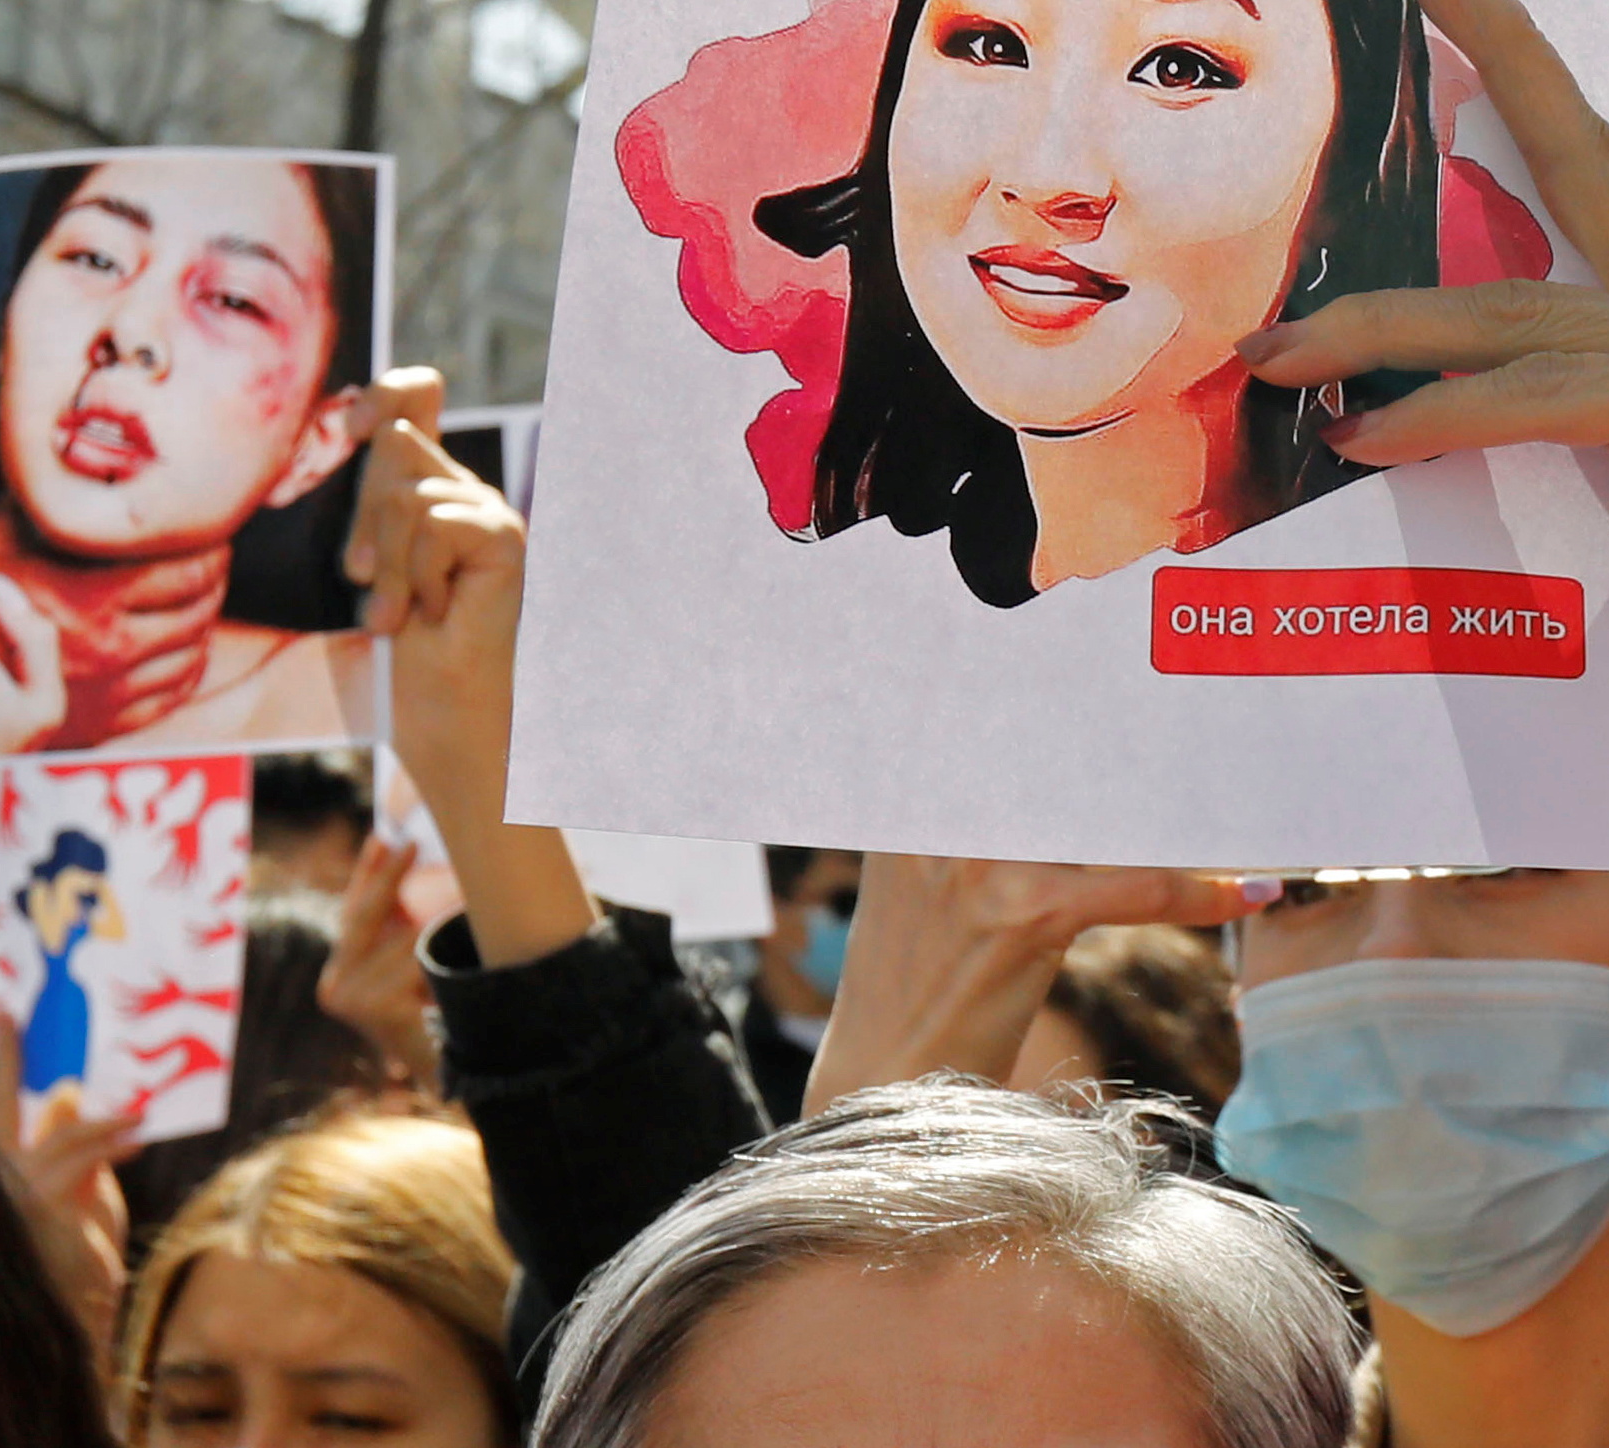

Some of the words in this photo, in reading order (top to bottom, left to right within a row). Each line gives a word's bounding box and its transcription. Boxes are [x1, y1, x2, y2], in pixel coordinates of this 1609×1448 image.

[1169, 603, 1253, 636] она
[1272, 603, 1430, 635] хотела
[1448, 605, 1568, 641] жить
